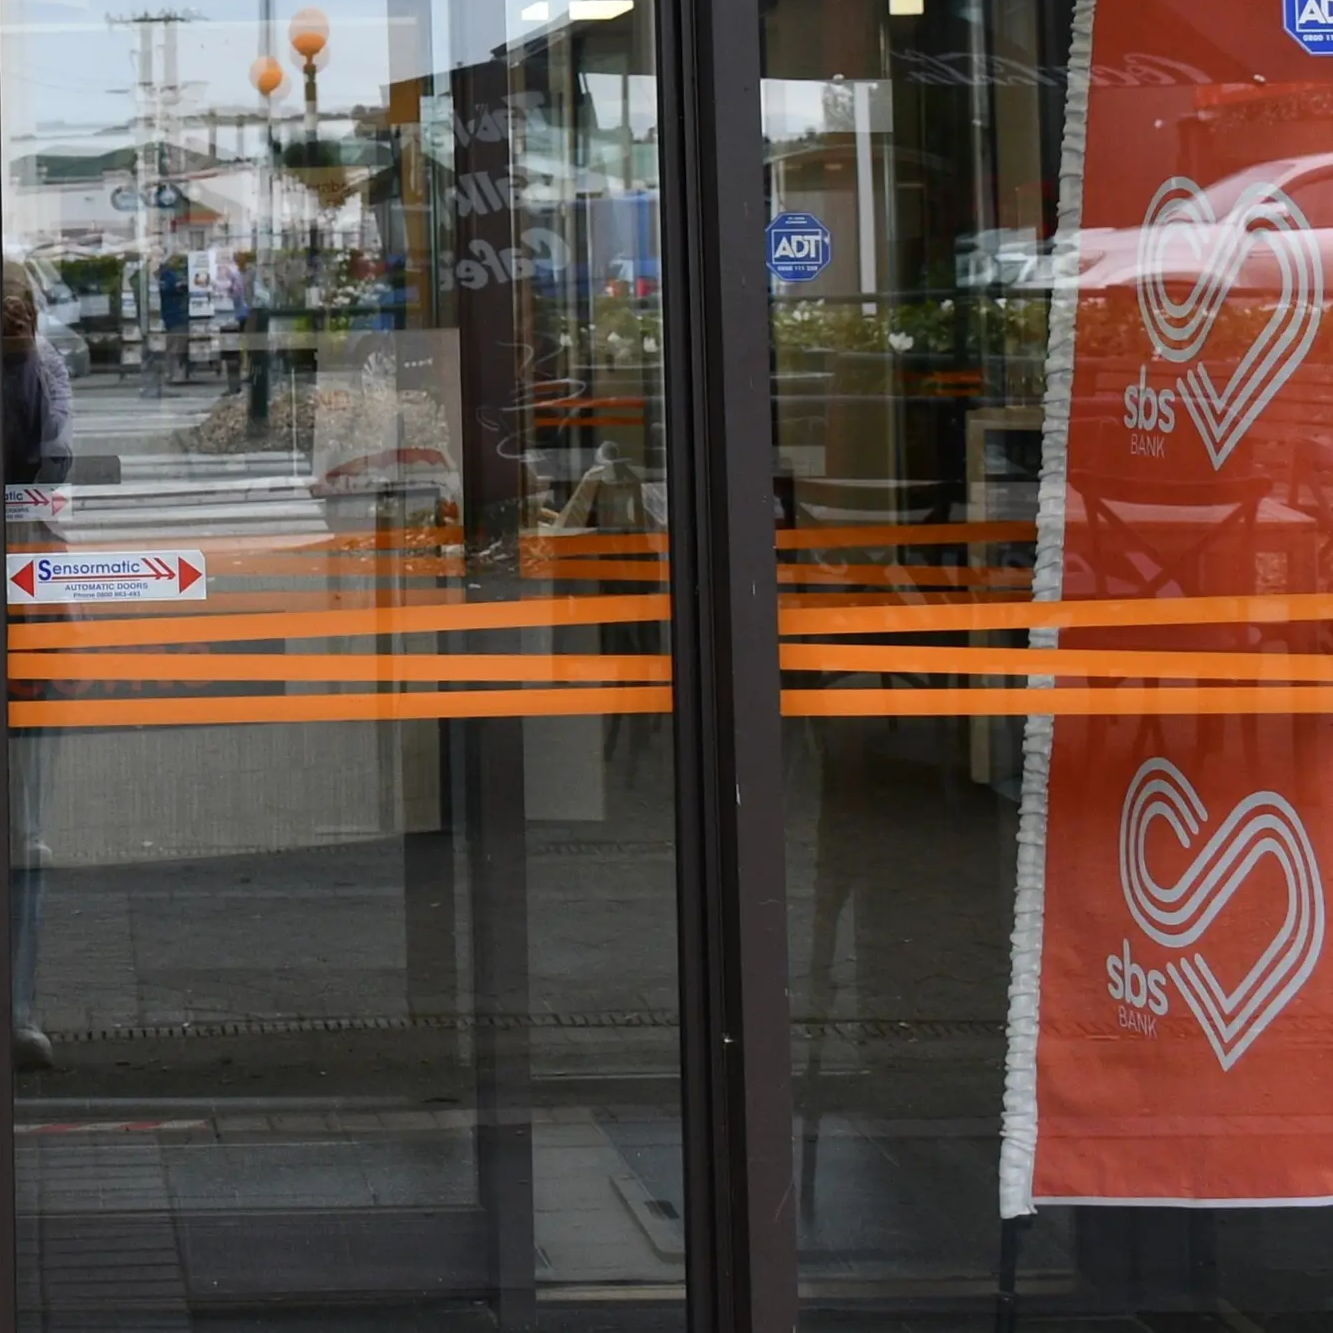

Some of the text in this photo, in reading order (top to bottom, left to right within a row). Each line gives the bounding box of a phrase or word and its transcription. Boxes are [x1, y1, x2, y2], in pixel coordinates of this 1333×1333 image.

[774, 234, 821, 258] ADT
[1124, 364, 1175, 433] sbs
[1131, 433, 1165, 459] BANK
[38, 559, 140, 581] Sensormatic
[65, 582, 149, 591] AUTOMATIC DOORS
[1106, 938, 1169, 1016] sbs
[1118, 1005, 1158, 1039] BANK
